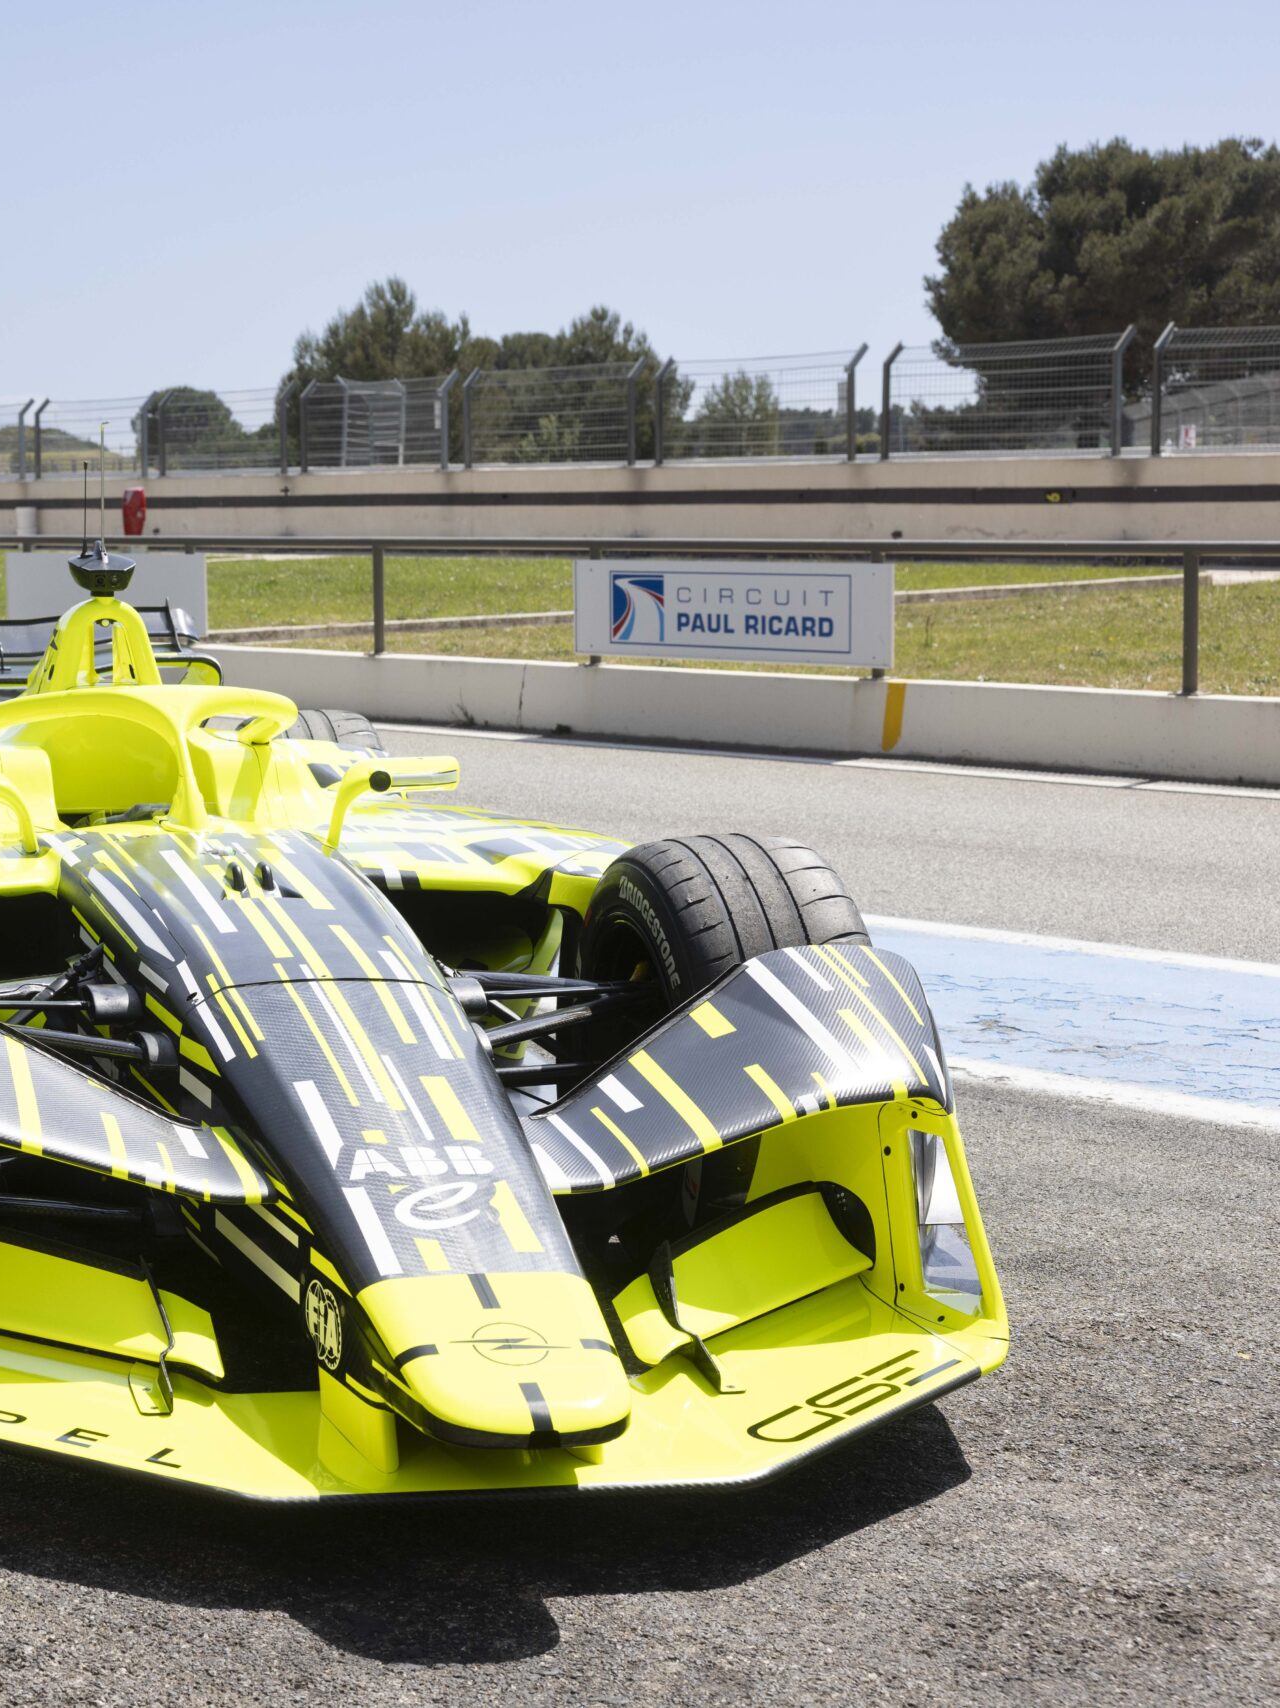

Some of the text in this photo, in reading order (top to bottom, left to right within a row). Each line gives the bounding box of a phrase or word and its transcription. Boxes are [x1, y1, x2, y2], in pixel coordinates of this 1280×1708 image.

[676, 586, 834, 607] CIRCUIT
[677, 612, 834, 637] PAUL RICARD
[618, 875, 681, 991] BRIDGESTONE
[349, 1145, 495, 1181] ABB
[746, 1349, 961, 1443] GSE
